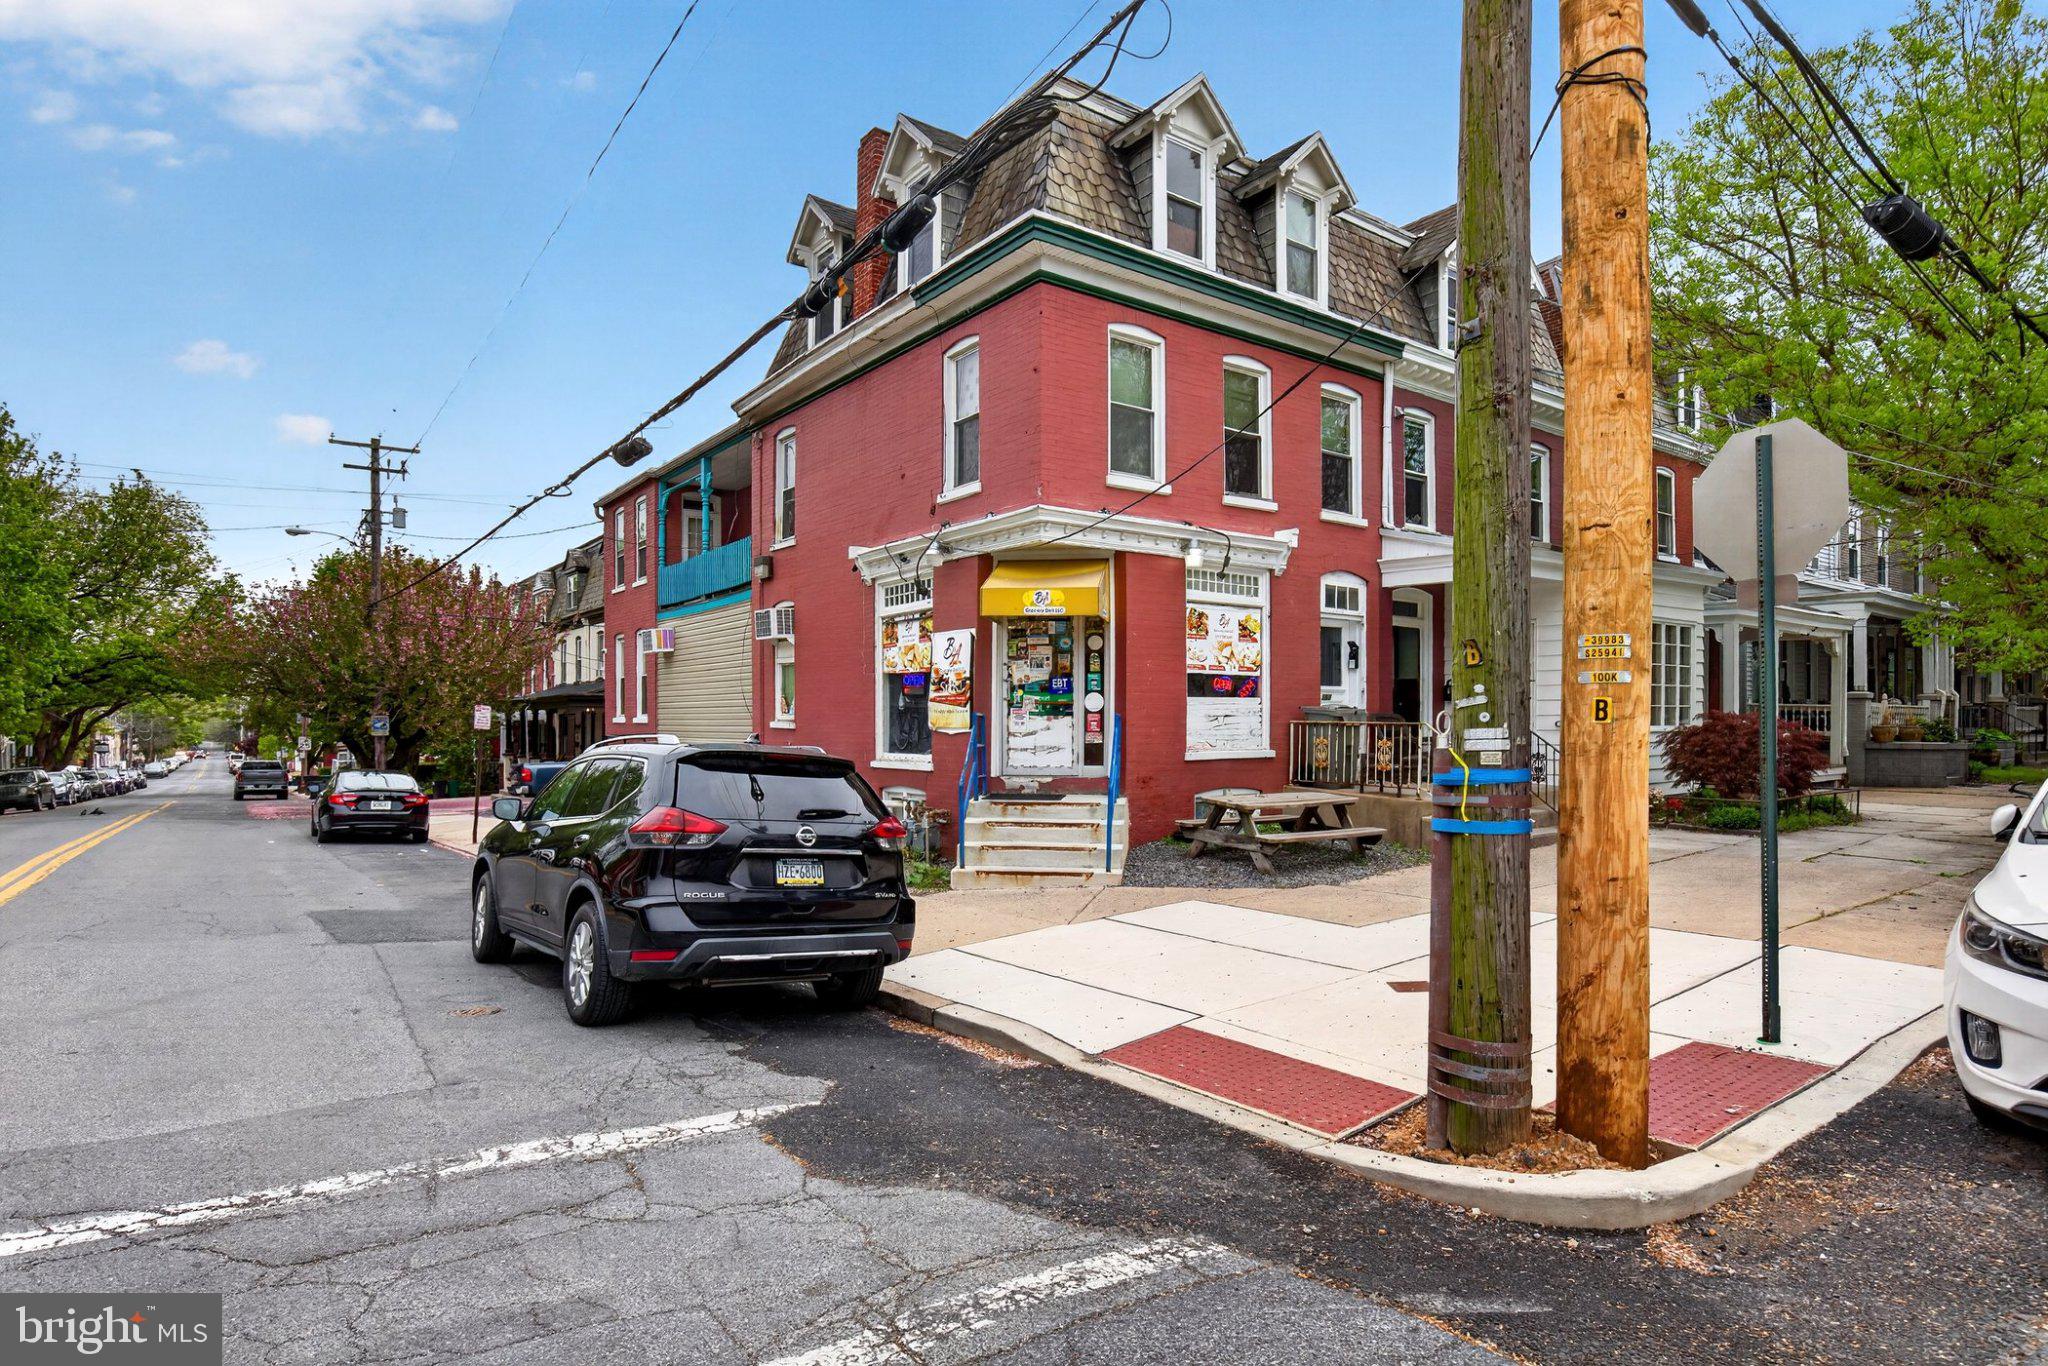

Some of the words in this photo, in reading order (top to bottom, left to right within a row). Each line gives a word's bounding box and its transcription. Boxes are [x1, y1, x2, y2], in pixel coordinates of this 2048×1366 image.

[902, 674, 925, 687] OPEN
[1593, 672, 1618, 682] 100K
[1052, 678, 1068, 688] EBT
[1595, 699, 1609, 721] B
